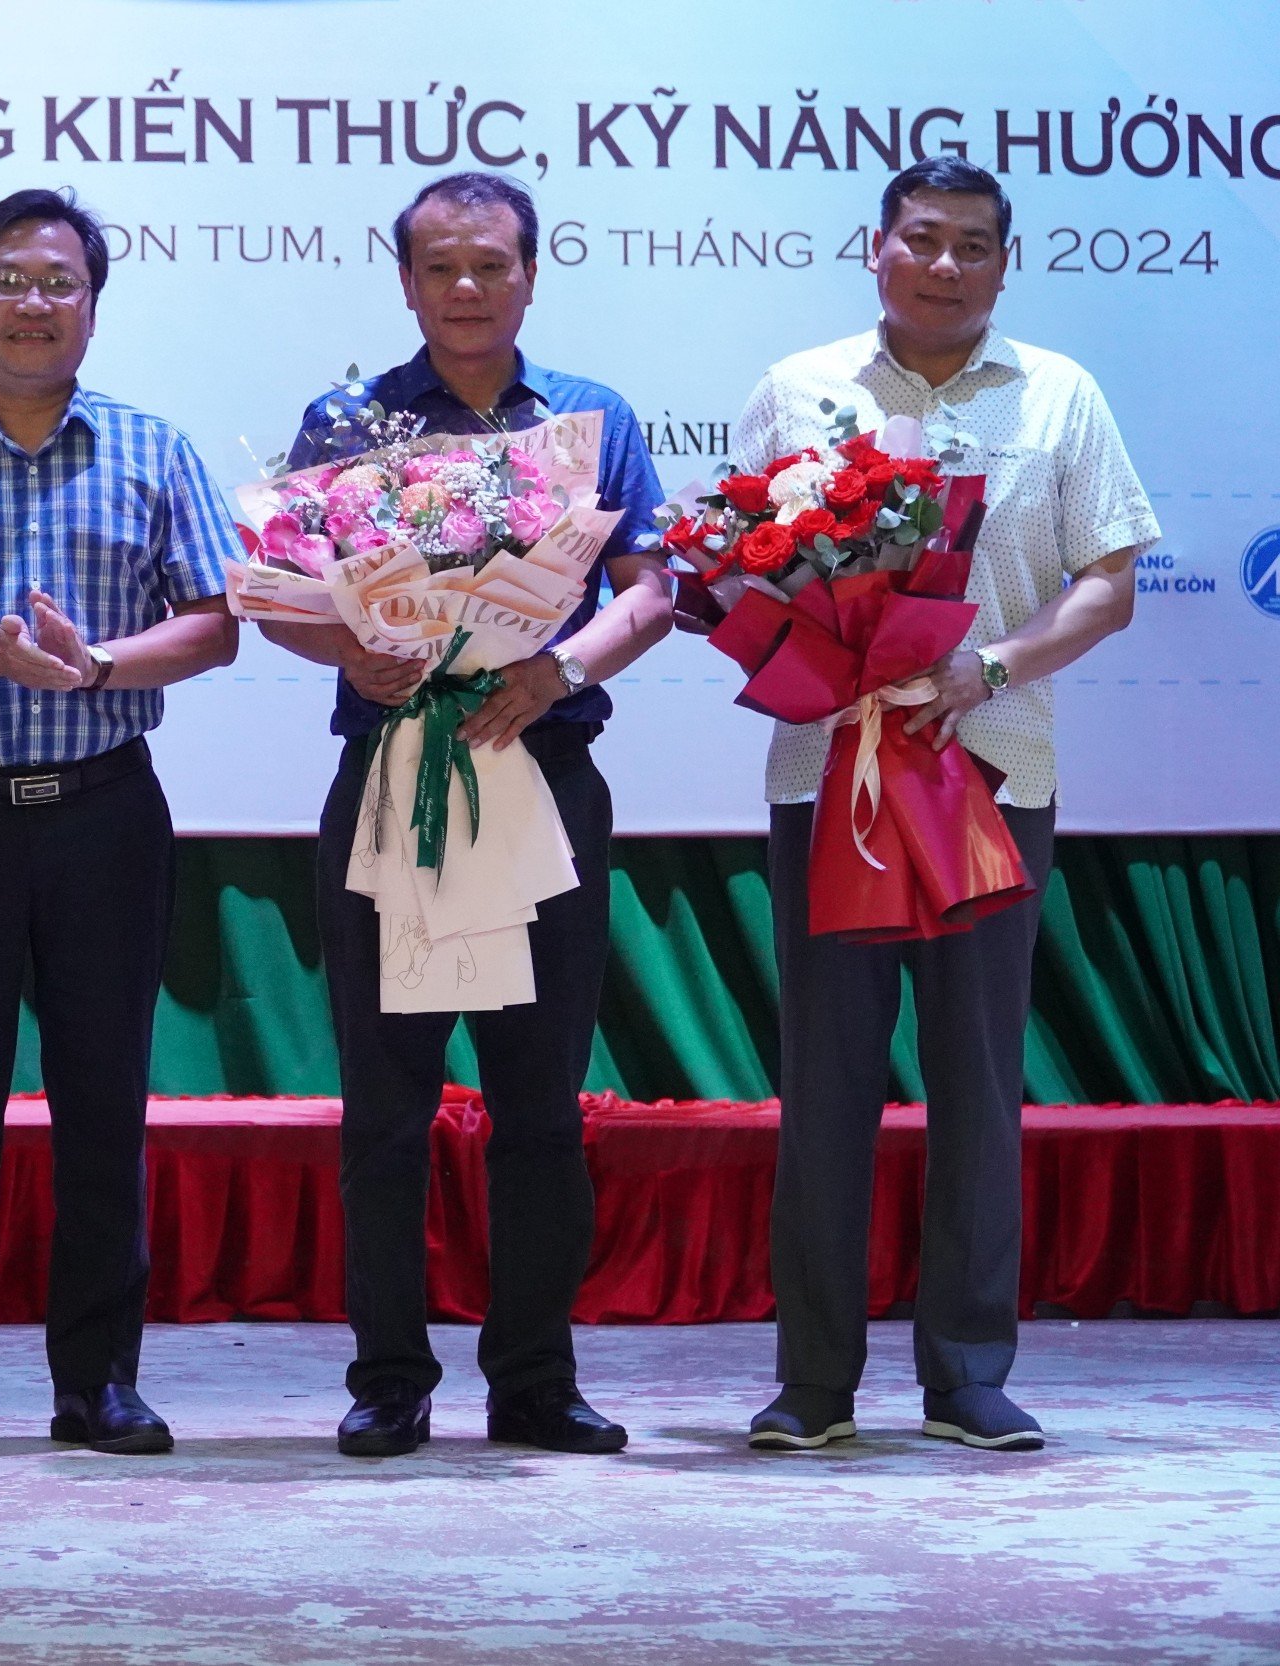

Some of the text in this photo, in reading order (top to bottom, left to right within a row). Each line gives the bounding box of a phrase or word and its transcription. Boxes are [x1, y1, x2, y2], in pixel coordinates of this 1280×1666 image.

[44, 68, 254, 163] KIẾN
[276, 81, 548, 179] THỨC,
[577, 87, 689, 168] KỸ
[713, 88, 968, 171] NĂNG
[99, 224, 176, 261] ON
[197, 225, 341, 268] TUM,
[608, 218, 814, 268] THÁNG
[835, 225, 870, 269] 4
[1047, 227, 1219, 275] 2024
[1137, 573, 1215, 593] SÀI GÒN
